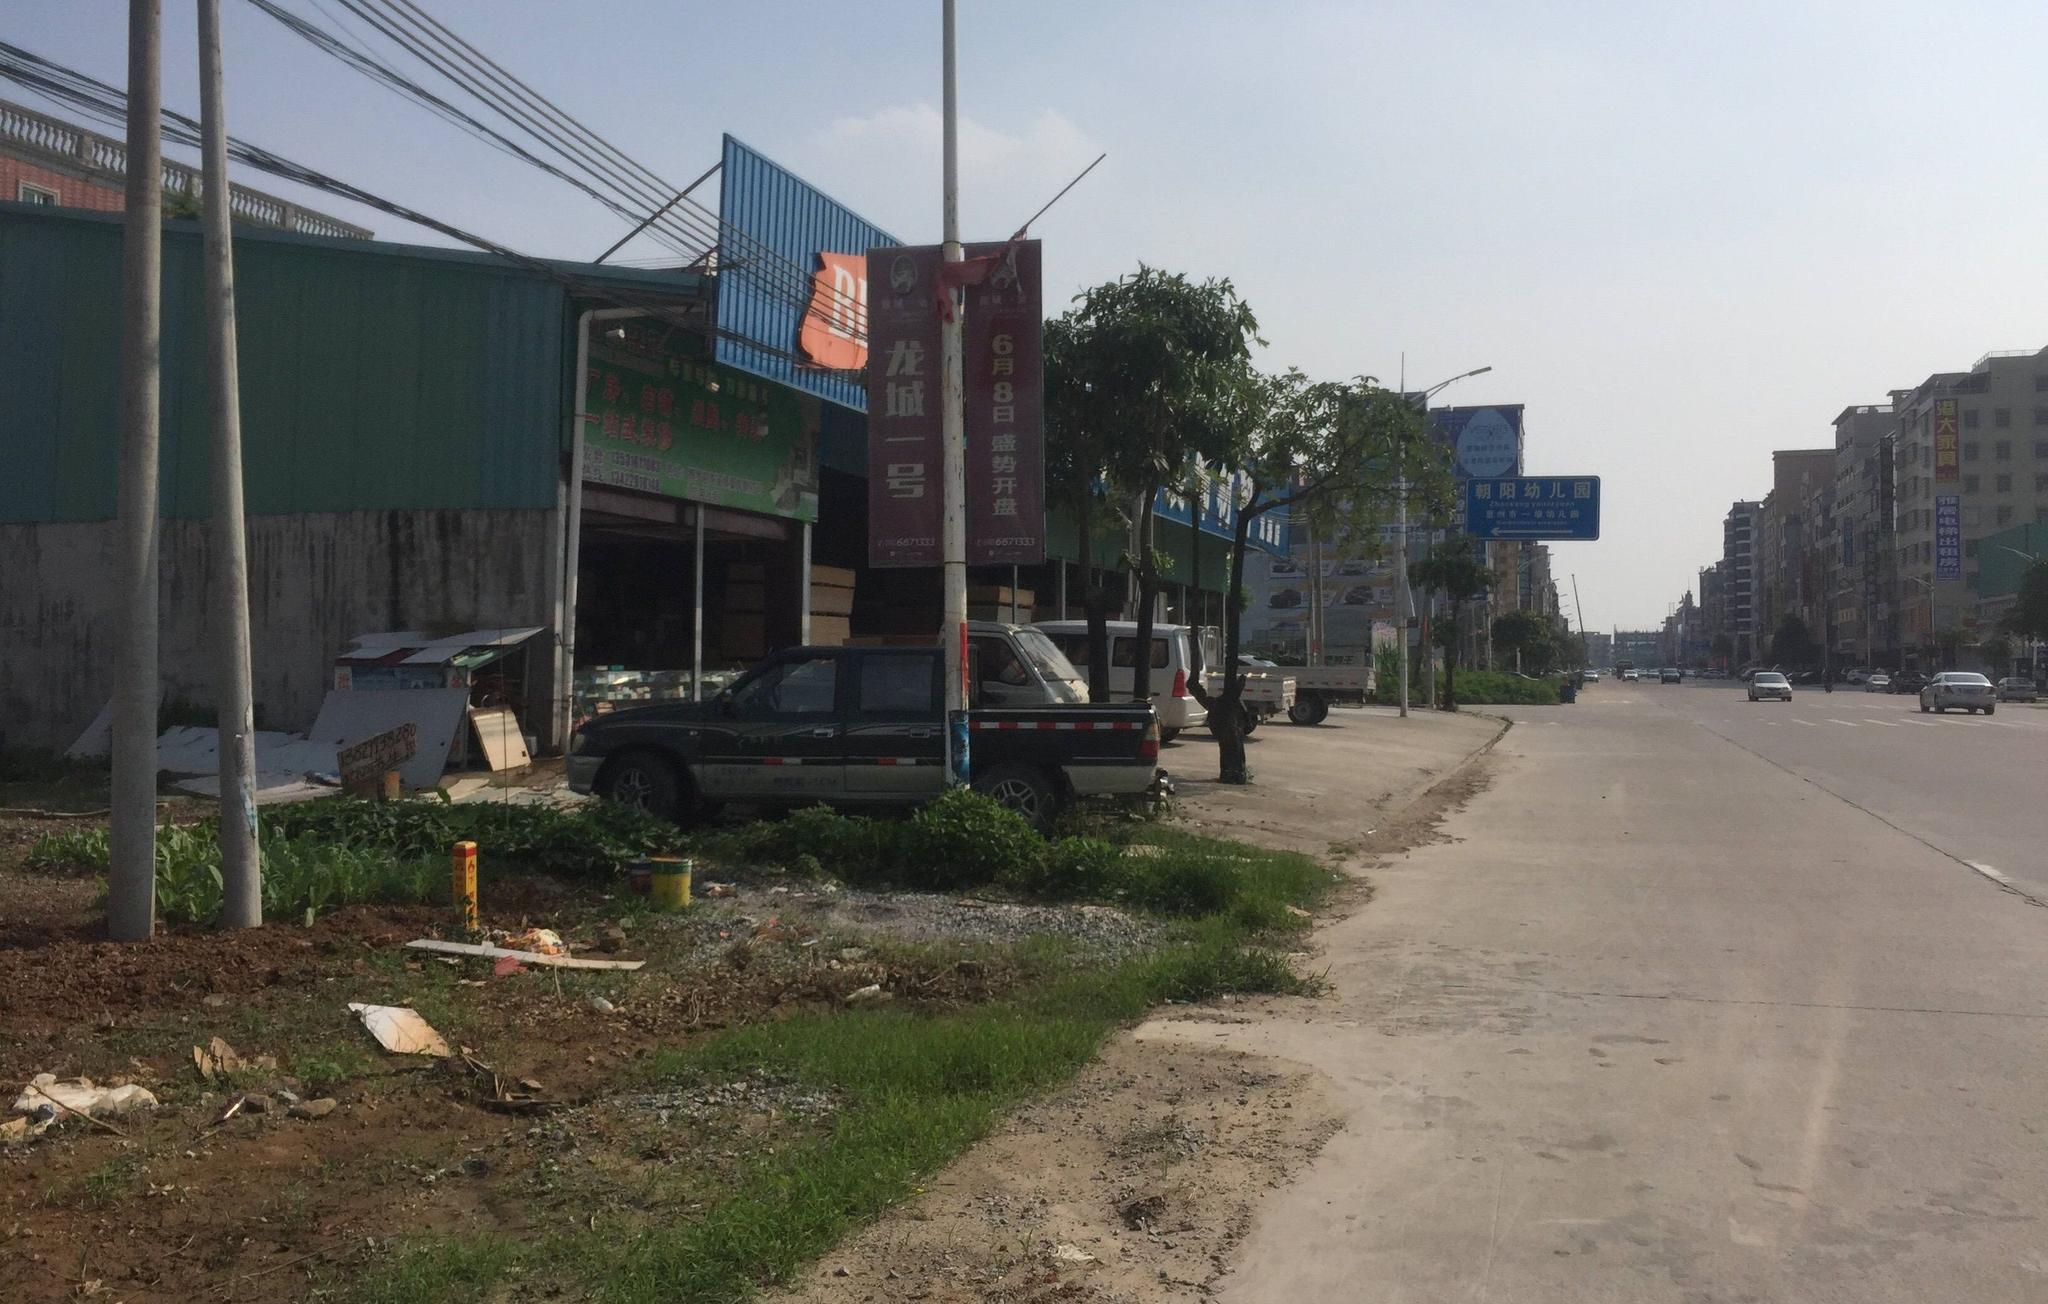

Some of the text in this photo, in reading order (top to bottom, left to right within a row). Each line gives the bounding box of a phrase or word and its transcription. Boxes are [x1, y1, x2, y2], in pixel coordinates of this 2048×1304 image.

[885, 340, 928, 499] 龙城一号
[992, 333, 1015, 424] 6月8日
[991, 433, 1017, 516] 盛势开盘
[1475, 482, 1591, 499] 朝阳幼儿园
